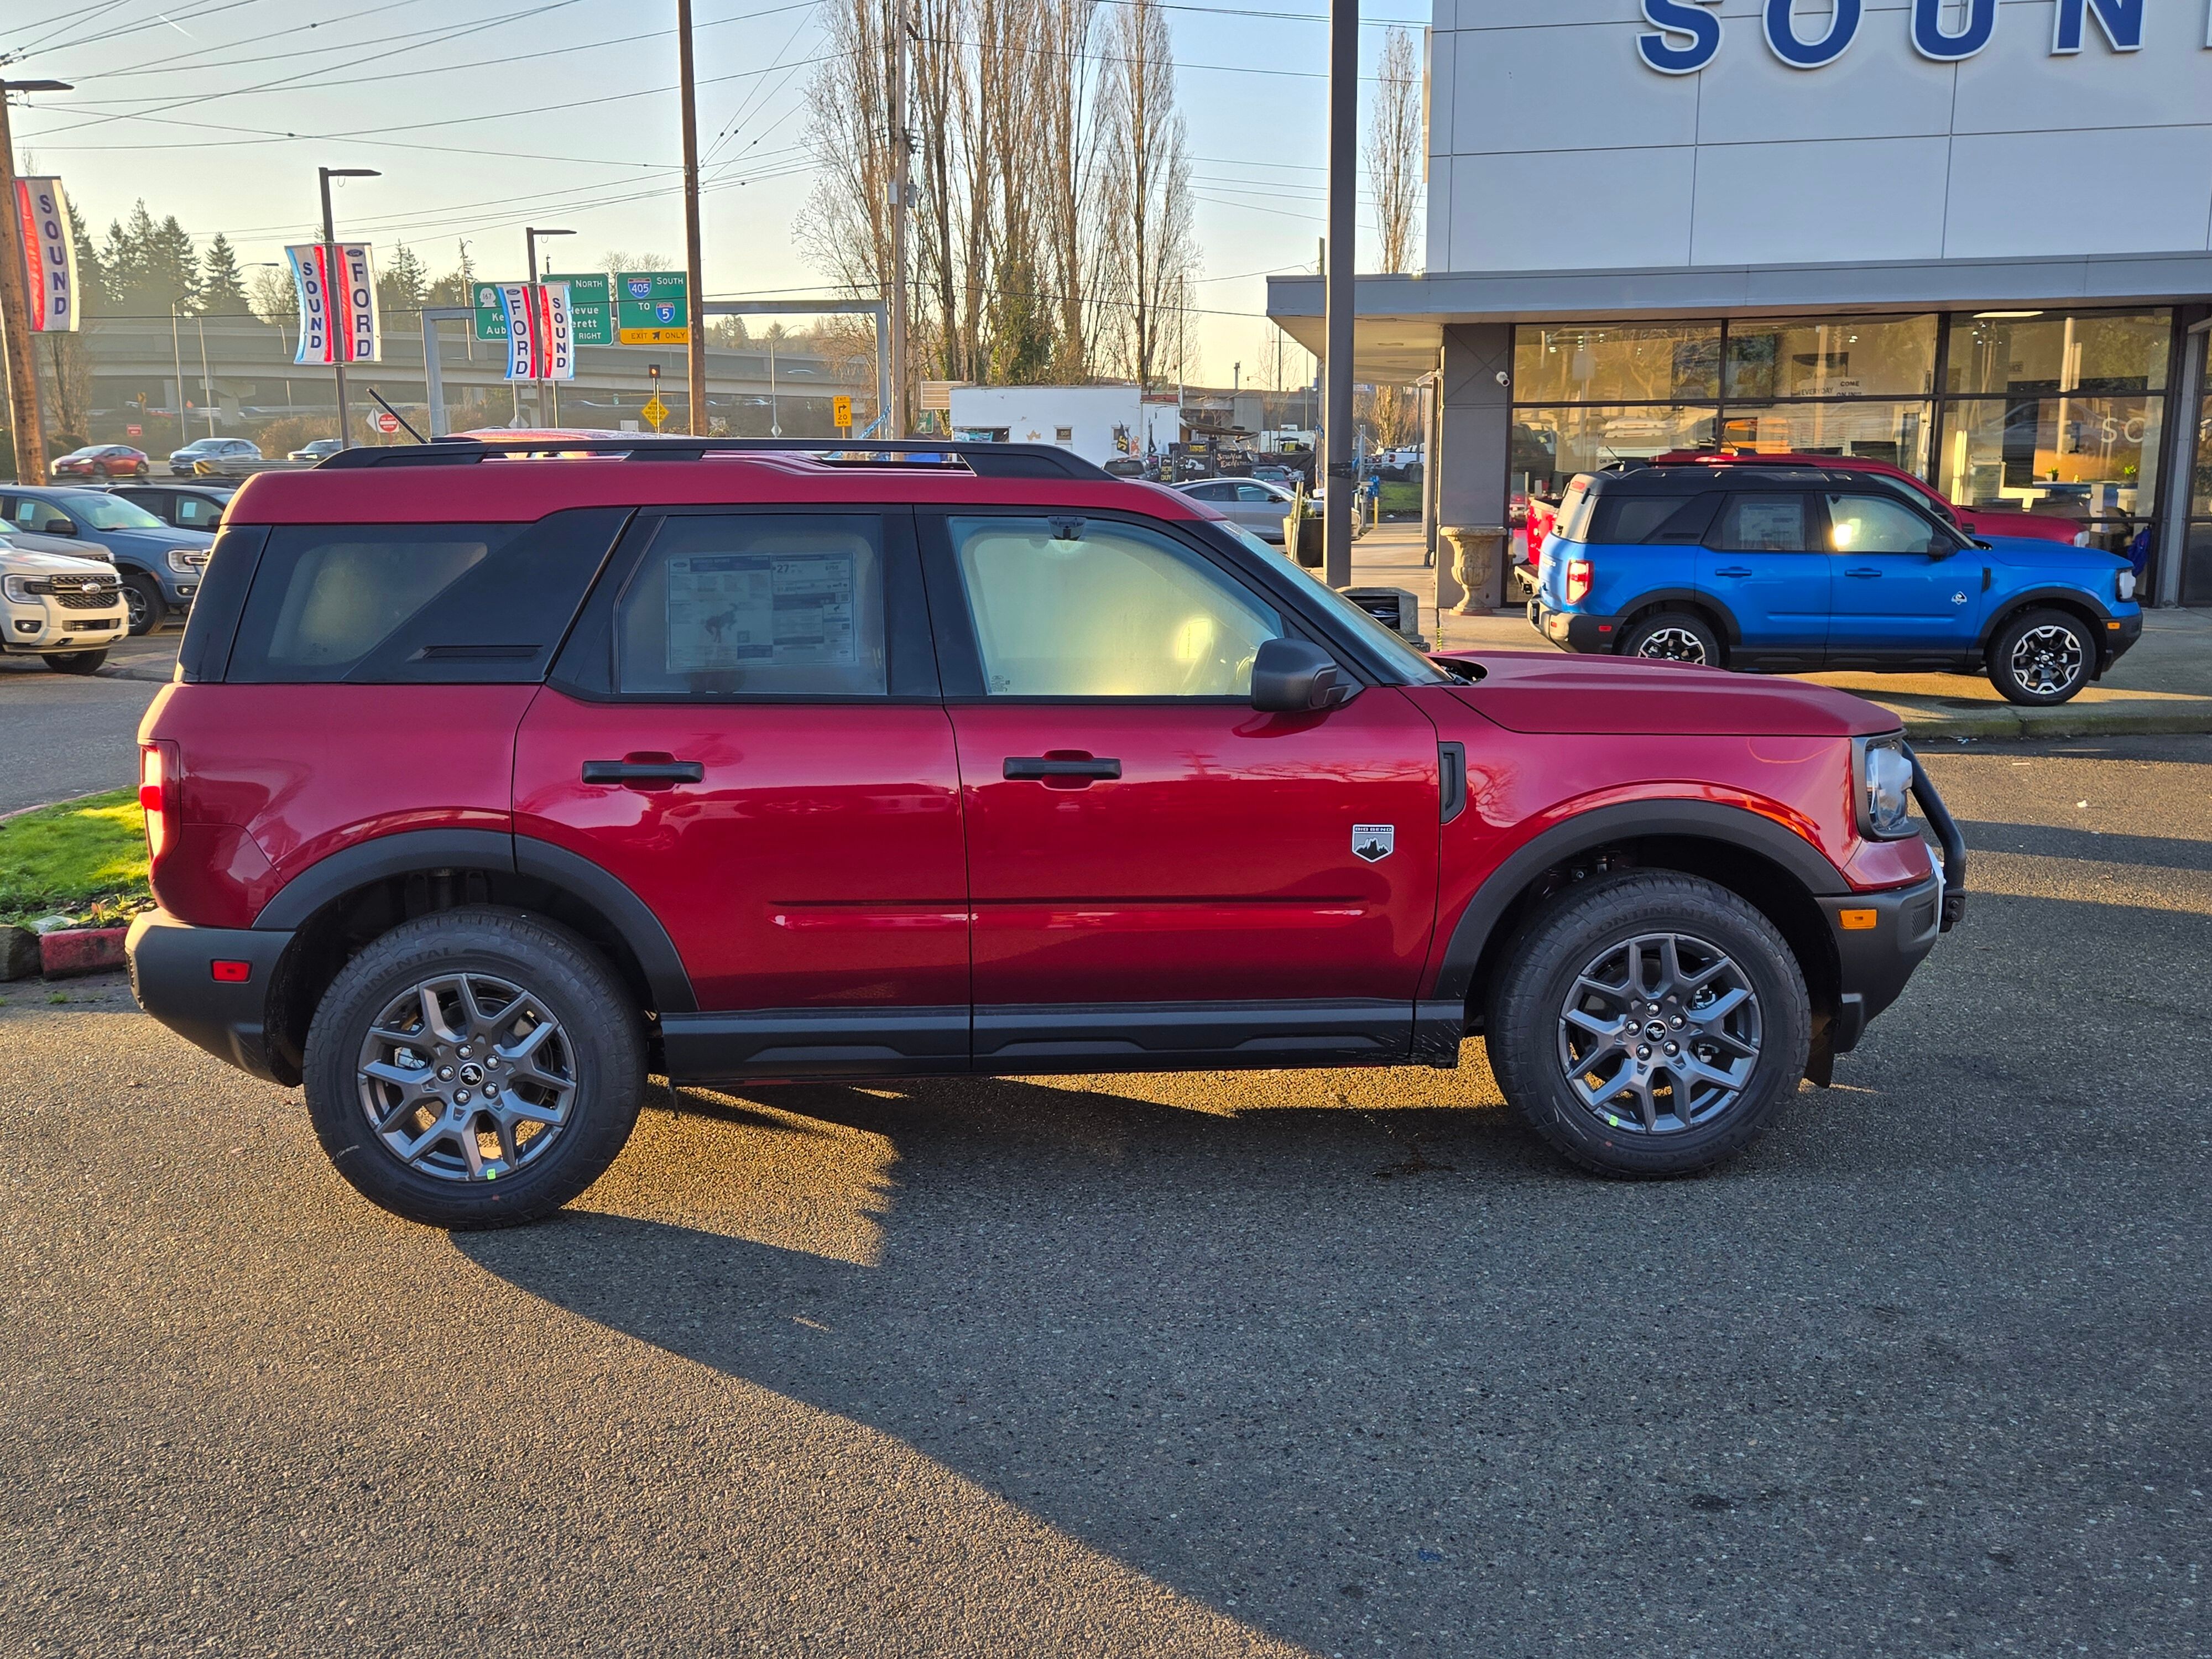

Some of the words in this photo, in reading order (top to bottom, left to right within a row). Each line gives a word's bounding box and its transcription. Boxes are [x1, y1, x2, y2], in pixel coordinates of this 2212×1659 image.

[1635, 0, 2212, 74] SOUN
[39, 195, 66, 315] SOUND
[303, 262, 322, 348] SOUND
[351, 263, 371, 357] FORD
[632, 284, 649, 293] 405
[662, 308, 670, 319] 5
[486, 325, 507, 335] Aub
[510, 300, 528, 374] FORD
[552, 298, 566, 368] SOUND
[572, 319, 597, 328] erett
[777, 564, 789, 573] 27
[1585, 906, 1730, 940] CONTINENTAL
